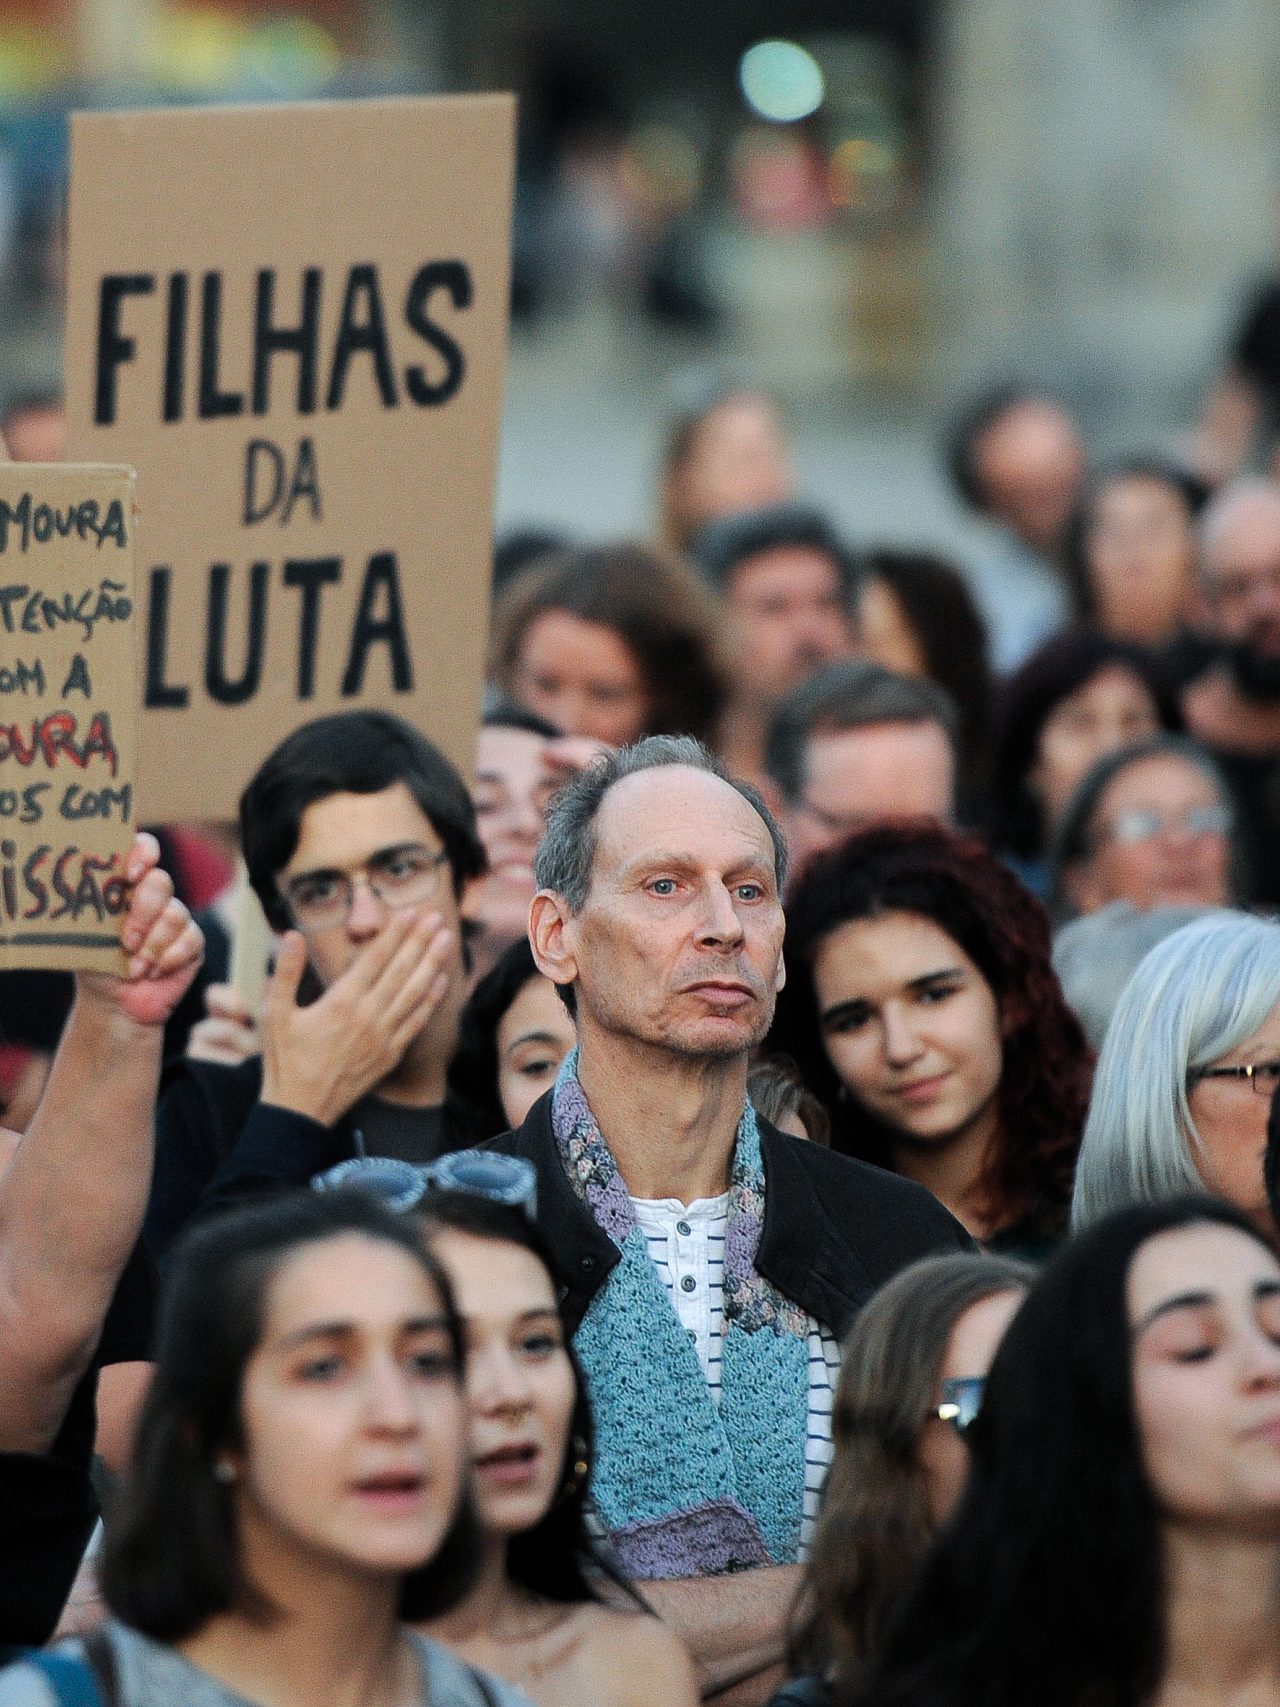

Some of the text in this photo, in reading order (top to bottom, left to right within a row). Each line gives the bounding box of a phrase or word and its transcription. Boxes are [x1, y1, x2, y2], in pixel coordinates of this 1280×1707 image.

[93, 258, 475, 426] FILHAS
[241, 436, 322, 527] DA
[61, 652, 92, 699] A
[143, 551, 415, 710] LUTA
[59, 783, 132, 825] COM
